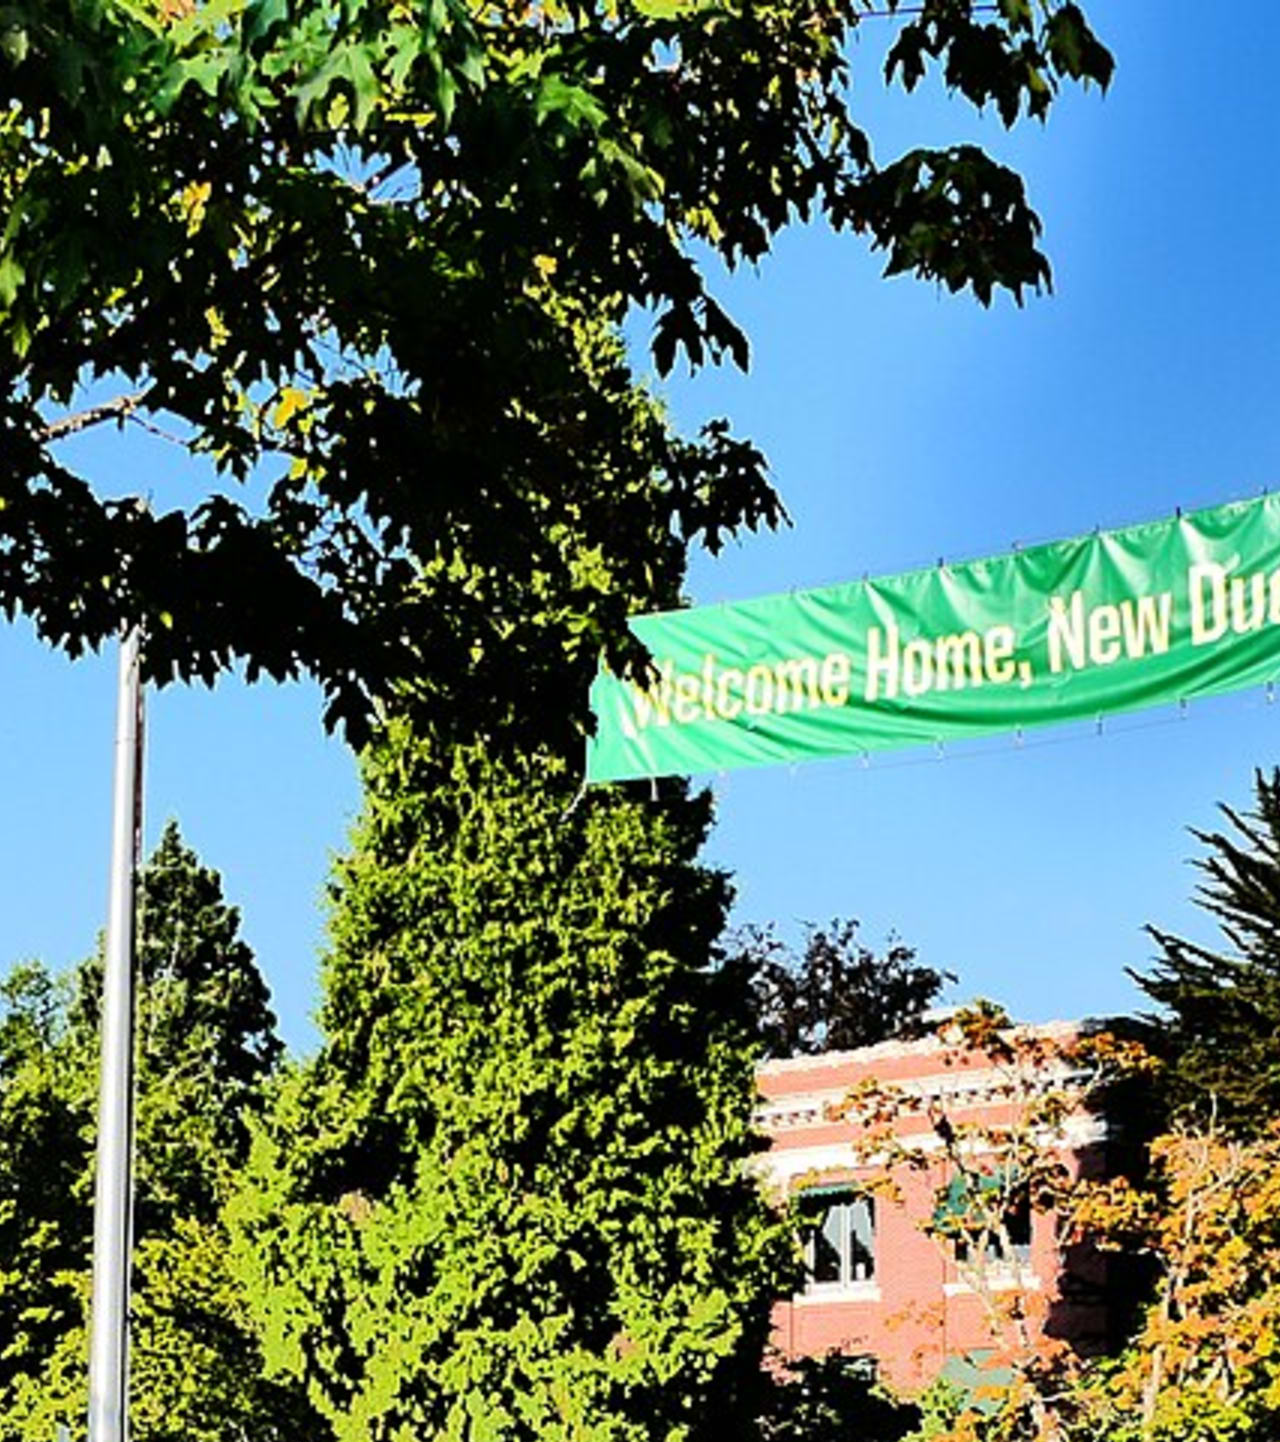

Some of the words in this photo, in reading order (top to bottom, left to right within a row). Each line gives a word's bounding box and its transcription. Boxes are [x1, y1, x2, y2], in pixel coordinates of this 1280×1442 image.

[625, 650, 851, 728] Welcome
[865, 624, 1031, 701] Home,
[1048, 590, 1172, 674] New
